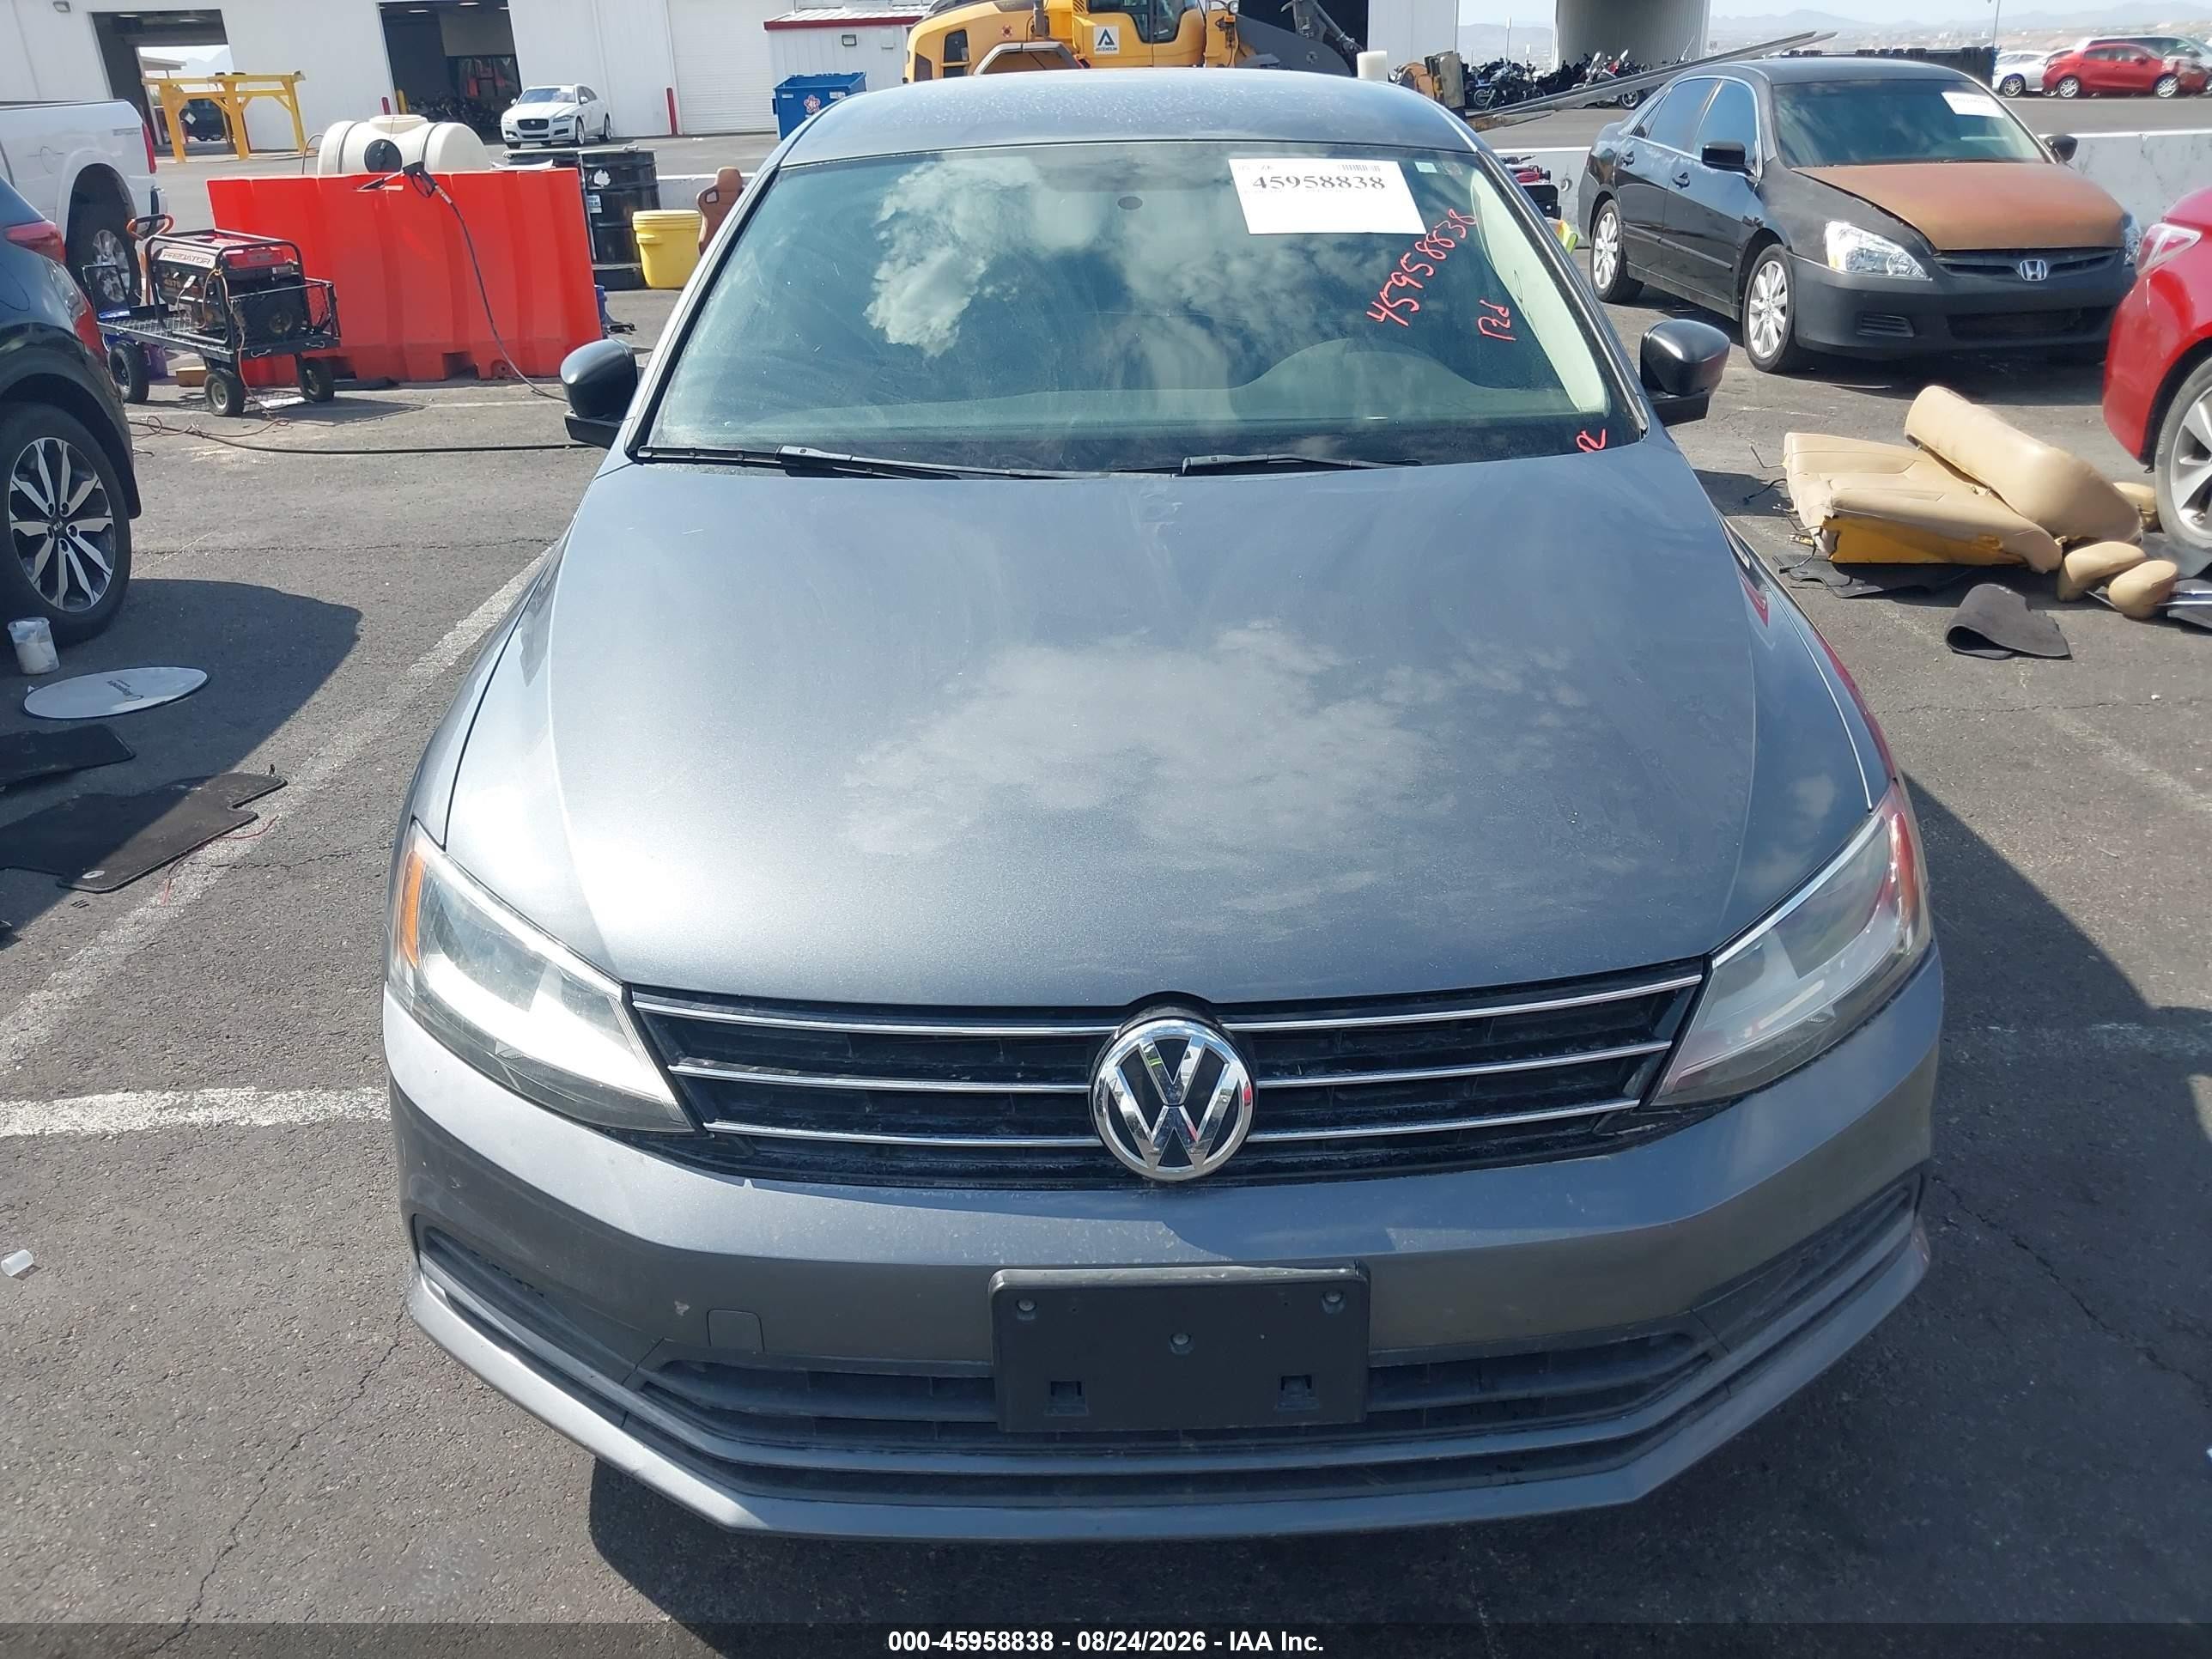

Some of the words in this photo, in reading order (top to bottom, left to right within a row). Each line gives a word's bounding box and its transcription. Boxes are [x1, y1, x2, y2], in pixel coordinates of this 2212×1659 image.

[1253, 175, 1387, 191] 45958838
[163, 252, 211, 264] PREDATOR
[1366, 208, 1477, 326] 45958838
